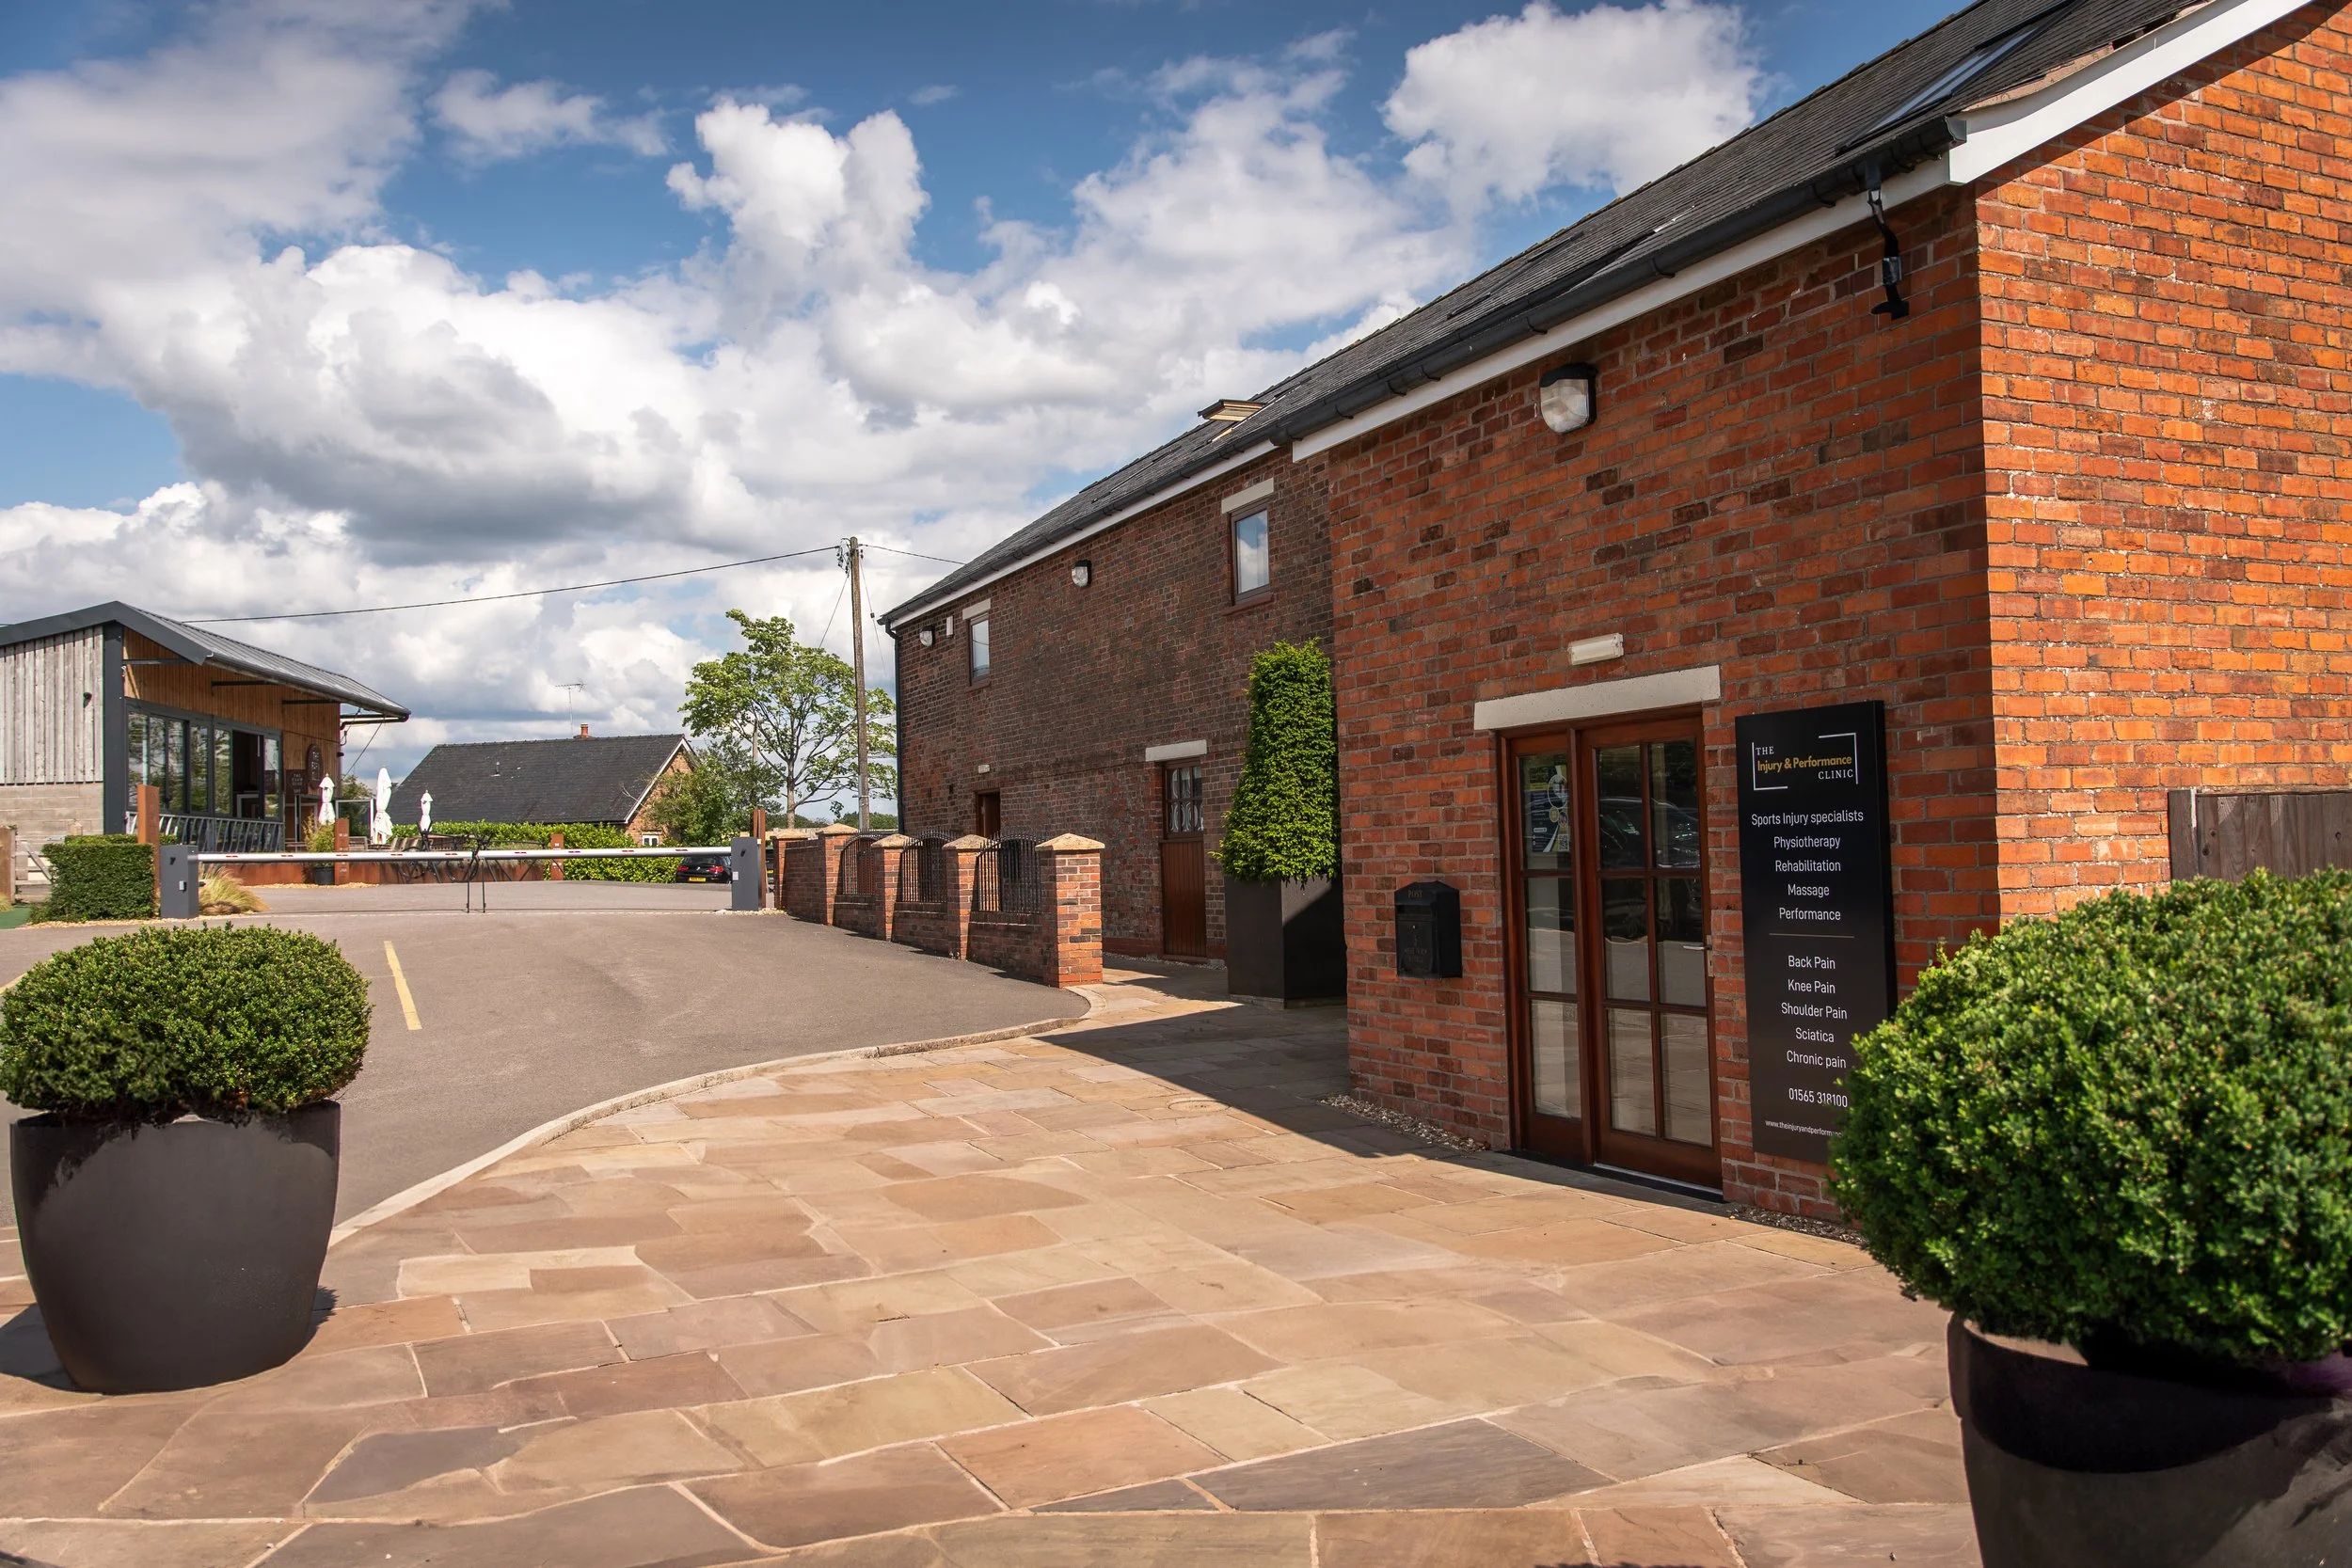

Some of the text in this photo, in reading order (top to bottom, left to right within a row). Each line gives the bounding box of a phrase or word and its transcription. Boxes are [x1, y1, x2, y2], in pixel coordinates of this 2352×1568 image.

[1756, 746, 1774, 755] THE
[1757, 755, 1852, 773] Injury & Performance
[1818, 768, 1853, 780] CLINIC
[1751, 809, 1864, 828] Sports Injury specialists
[1773, 835, 1841, 850] Physiotherapy
[1774, 859, 1841, 872] Rehabilitation
[1788, 883, 1830, 898] Massage
[1779, 907, 1841, 921] Performance
[1788, 955, 1836, 970] Back Pain
[1788, 978, 1836, 994] Knee Pain
[1781, 1002, 1848, 1020] Shoulder Pain
[1795, 1027, 1835, 1043] Sciatica
[1787, 1050, 1847, 1069] Chronic pain
[1788, 1087, 1848, 1108] 01565 318100
